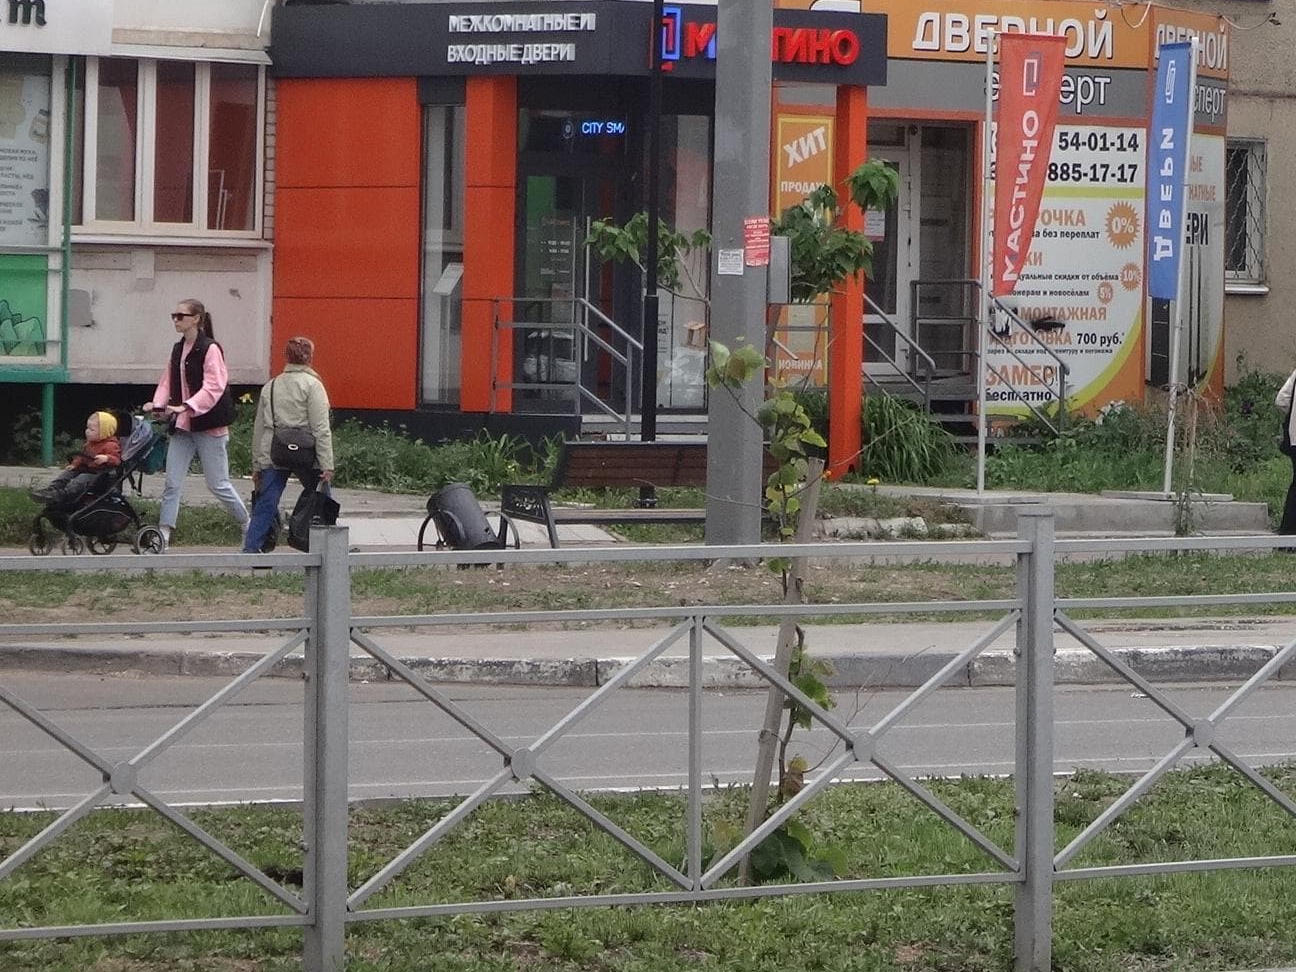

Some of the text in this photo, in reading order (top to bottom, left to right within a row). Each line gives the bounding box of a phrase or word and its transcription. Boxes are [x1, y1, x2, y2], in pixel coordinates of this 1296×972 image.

[449, 13, 581, 32] МЕЖКОМНАТНЫЕ
[447, 43, 576, 65] ВХОДНЫЕ ДВЕРИ
[581, 121, 604, 134] CITY
[783, 125, 827, 169] ХИТ
[1002, 109, 1039, 282] МАСТИНО
[1153, 128, 1174, 262] ДВЕРИ
[1076, 333, 1097, 345] 700
